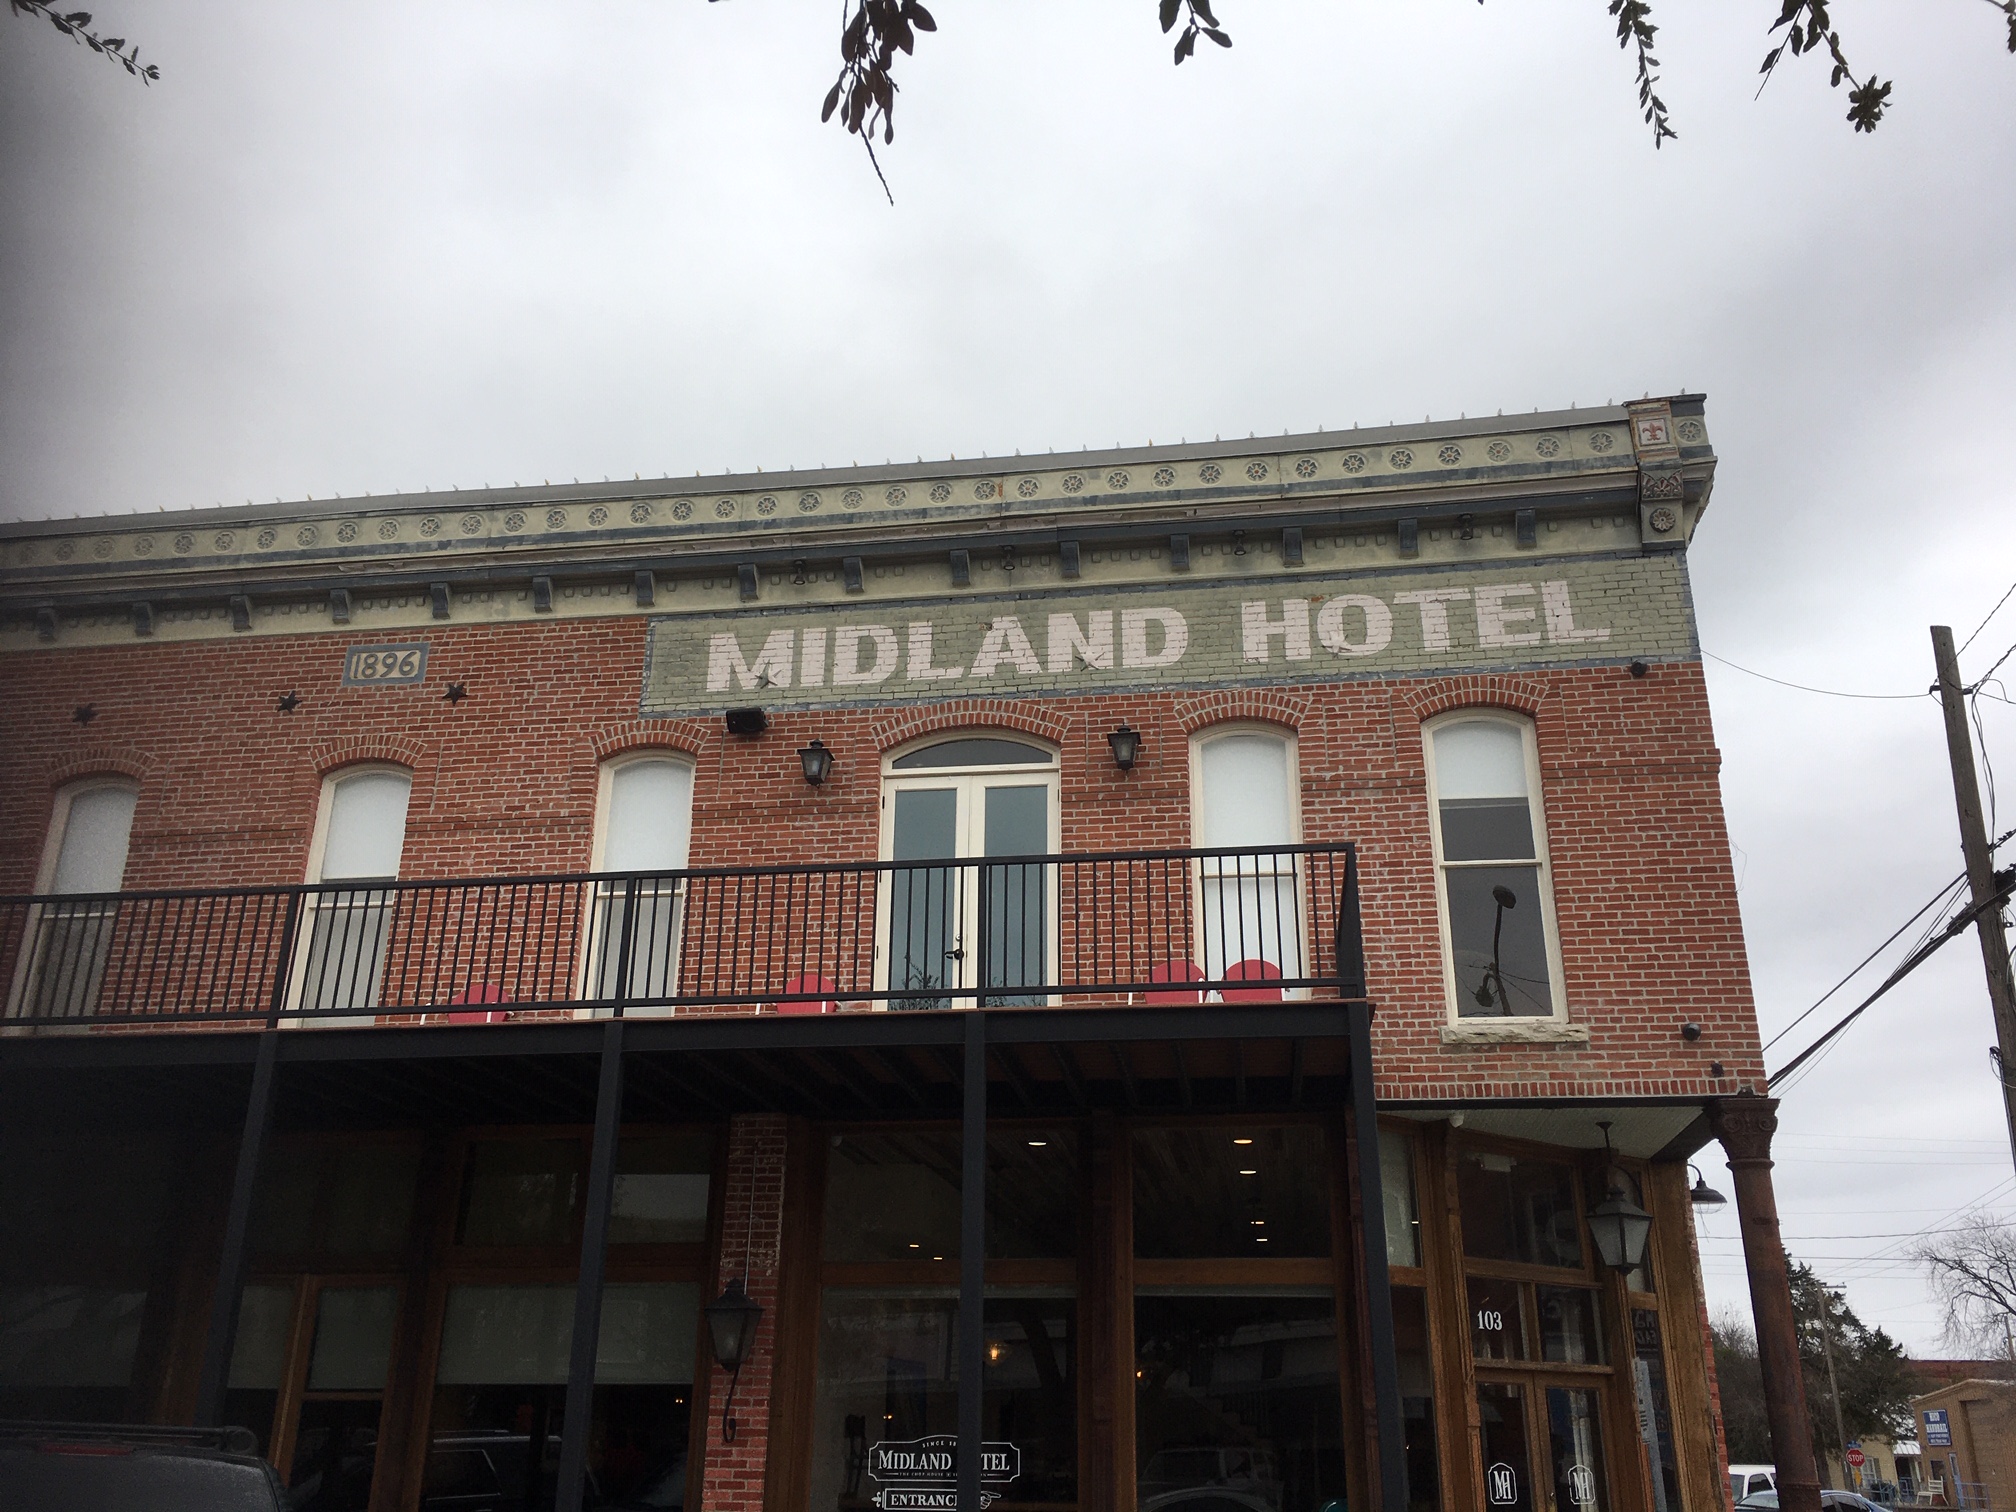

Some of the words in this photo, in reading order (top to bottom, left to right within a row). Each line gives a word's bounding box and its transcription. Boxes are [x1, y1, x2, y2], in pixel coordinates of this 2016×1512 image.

[705, 606, 1189, 693] MIDLAND
[1240, 580, 1612, 664] HOTEL
[353, 651, 418, 679] 1896
[1477, 1310, 1503, 1330] 103
[922, 1440, 945, 1448] SINCE
[878, 1450, 952, 1470] MIDLAND
[981, 1453, 1010, 1471] TEL
